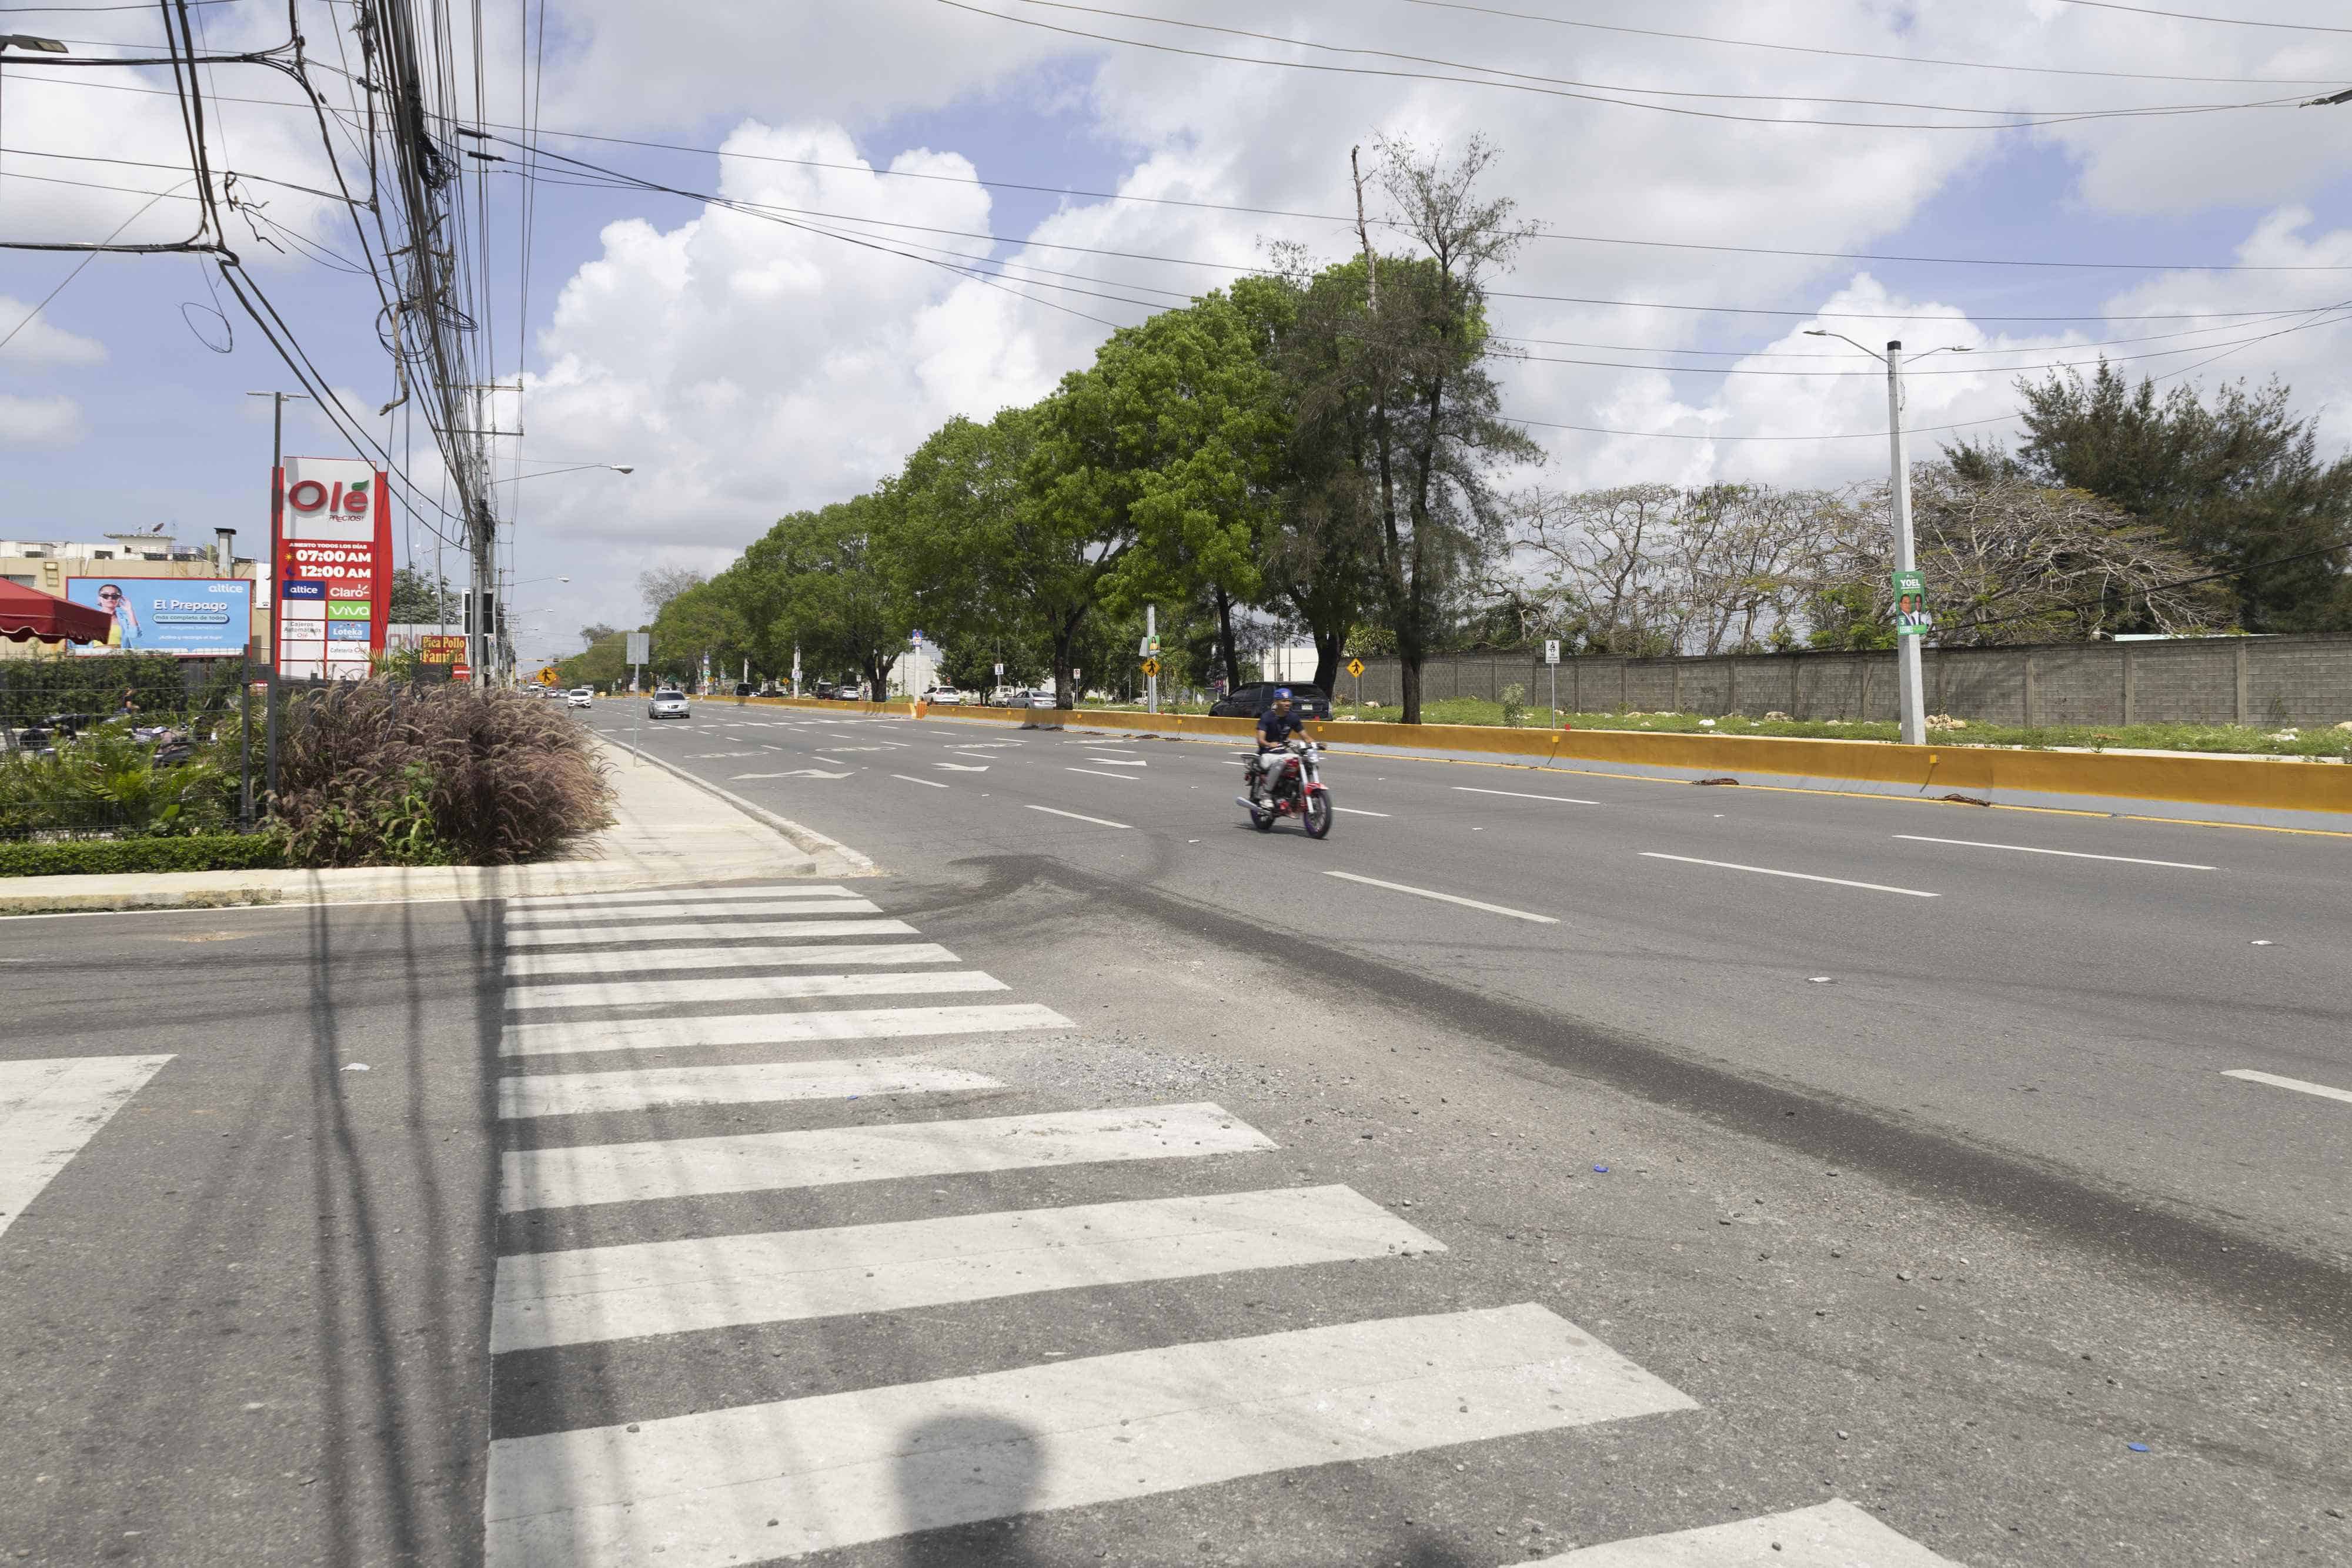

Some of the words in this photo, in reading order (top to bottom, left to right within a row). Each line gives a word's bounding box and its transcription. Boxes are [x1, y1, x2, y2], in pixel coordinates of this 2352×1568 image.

[289, 480, 369, 512] Olé
[296, 550, 346, 562] 07:00
[346, 553, 371, 562] AM
[300, 566, 345, 577] 12:00
[346, 569, 371, 578] AM
[208, 583, 244, 593] altice
[290, 586, 318, 594] altice
[330, 586, 364, 597] Claro
[153, 600, 167, 610] El
[171, 600, 228, 613] Prepago
[329, 606, 369, 616] viva
[423, 637, 441, 648] Pica
[442, 637, 465, 648] Pollo
